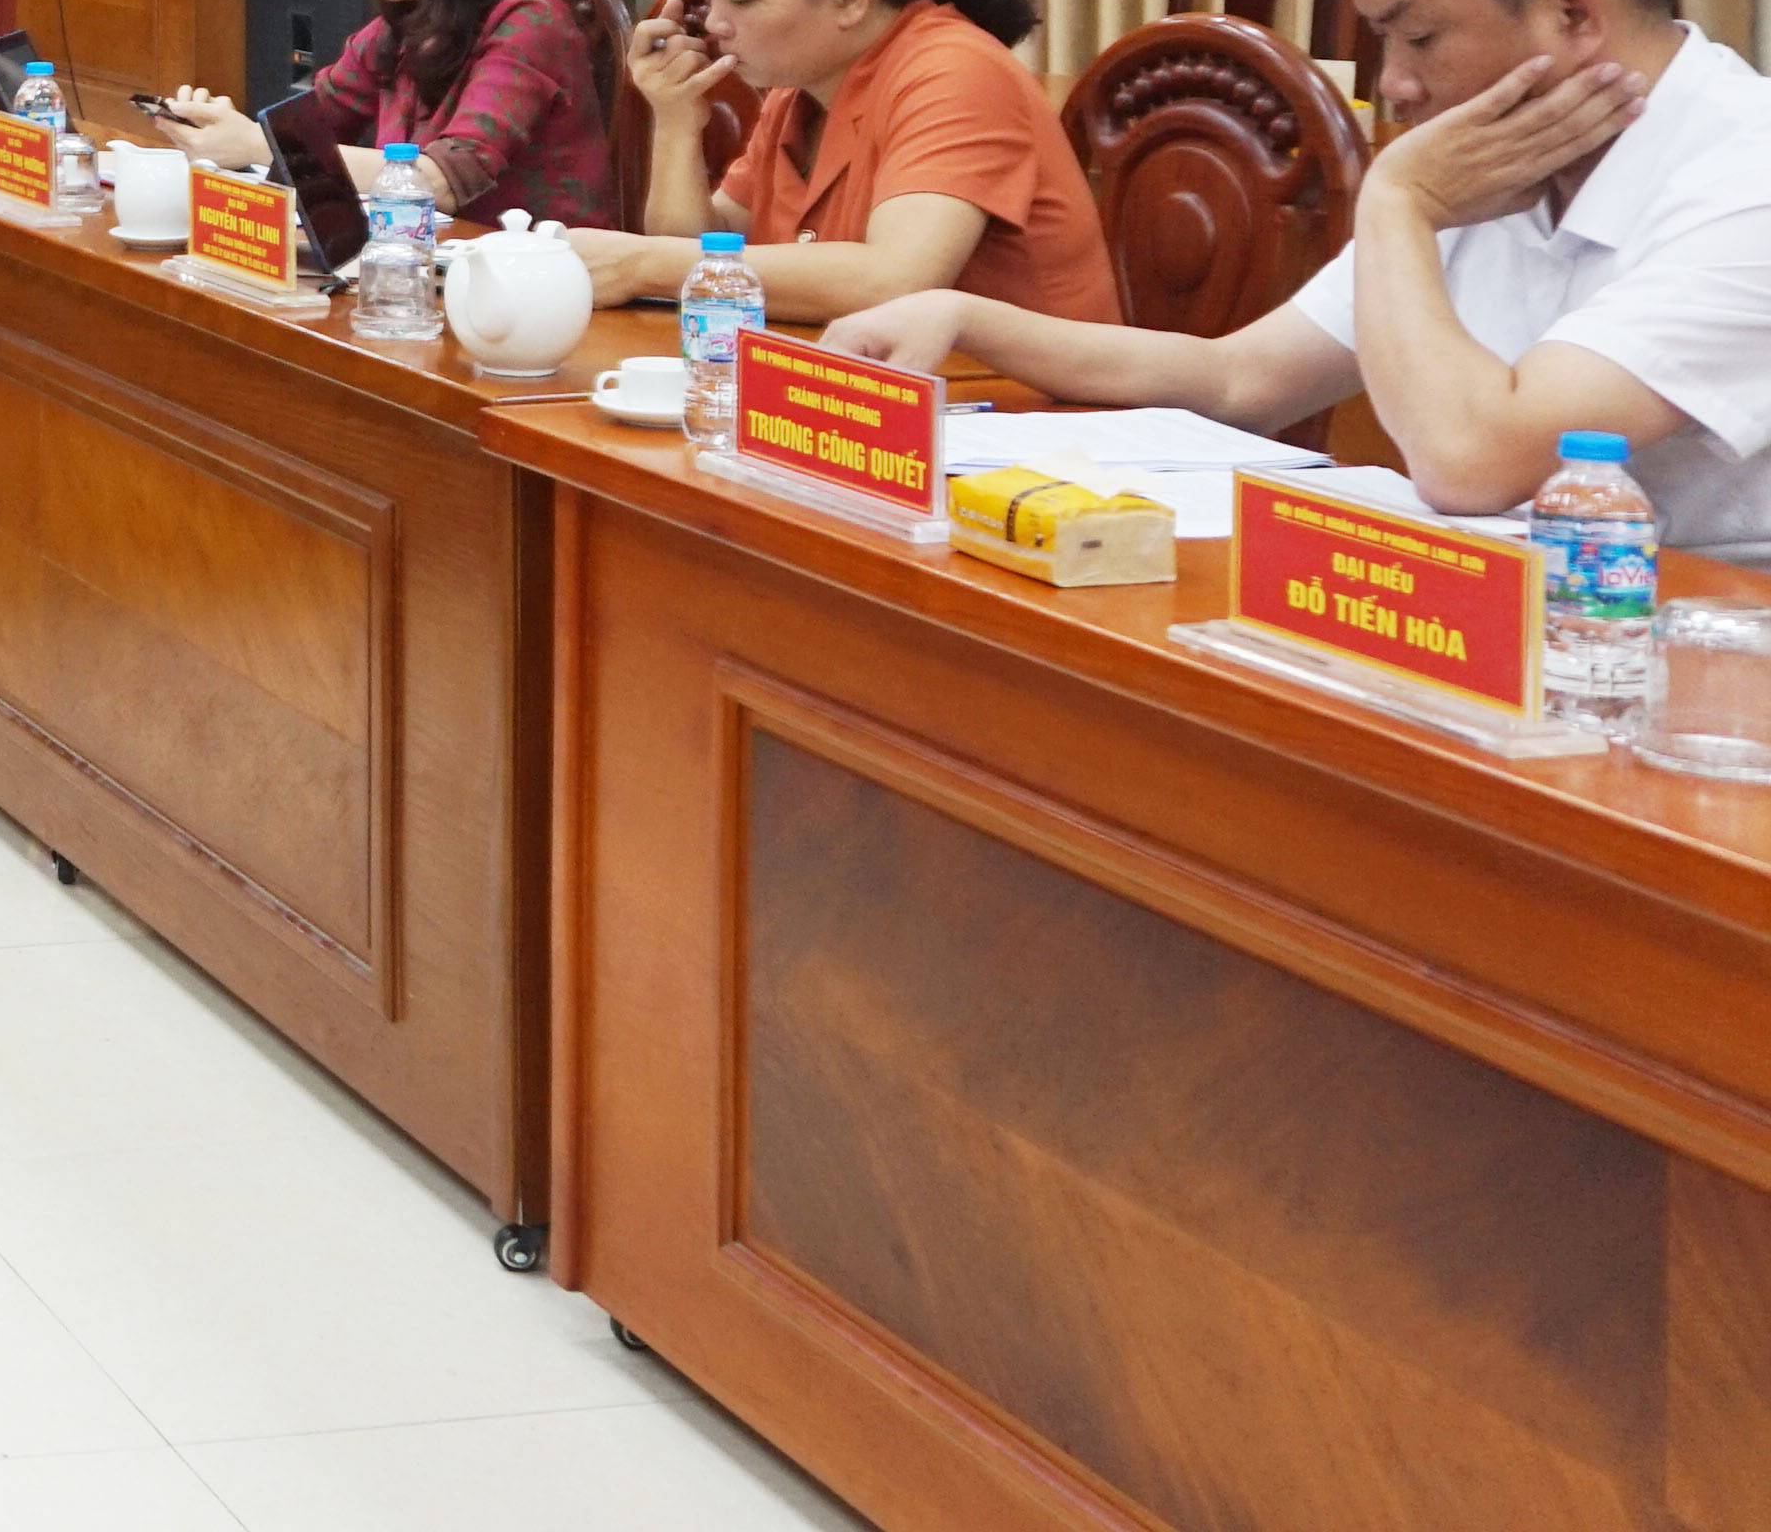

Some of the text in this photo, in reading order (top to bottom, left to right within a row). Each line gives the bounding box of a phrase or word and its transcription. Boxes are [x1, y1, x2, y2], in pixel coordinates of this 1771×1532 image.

[199, 205, 237, 231] NGUYỄN
[239, 218, 255, 242] THỊ
[257, 223, 280, 245] LINH
[788, 385, 881, 427] CHÁNH VĂN PHÒNG
[748, 409, 926, 490] TRƯƠNG CÔNG QUYẾT
[1332, 552, 1414, 594] ĐẠI BIỂU
[1288, 576, 1467, 661] ĐỖ TIẾN HÒA
